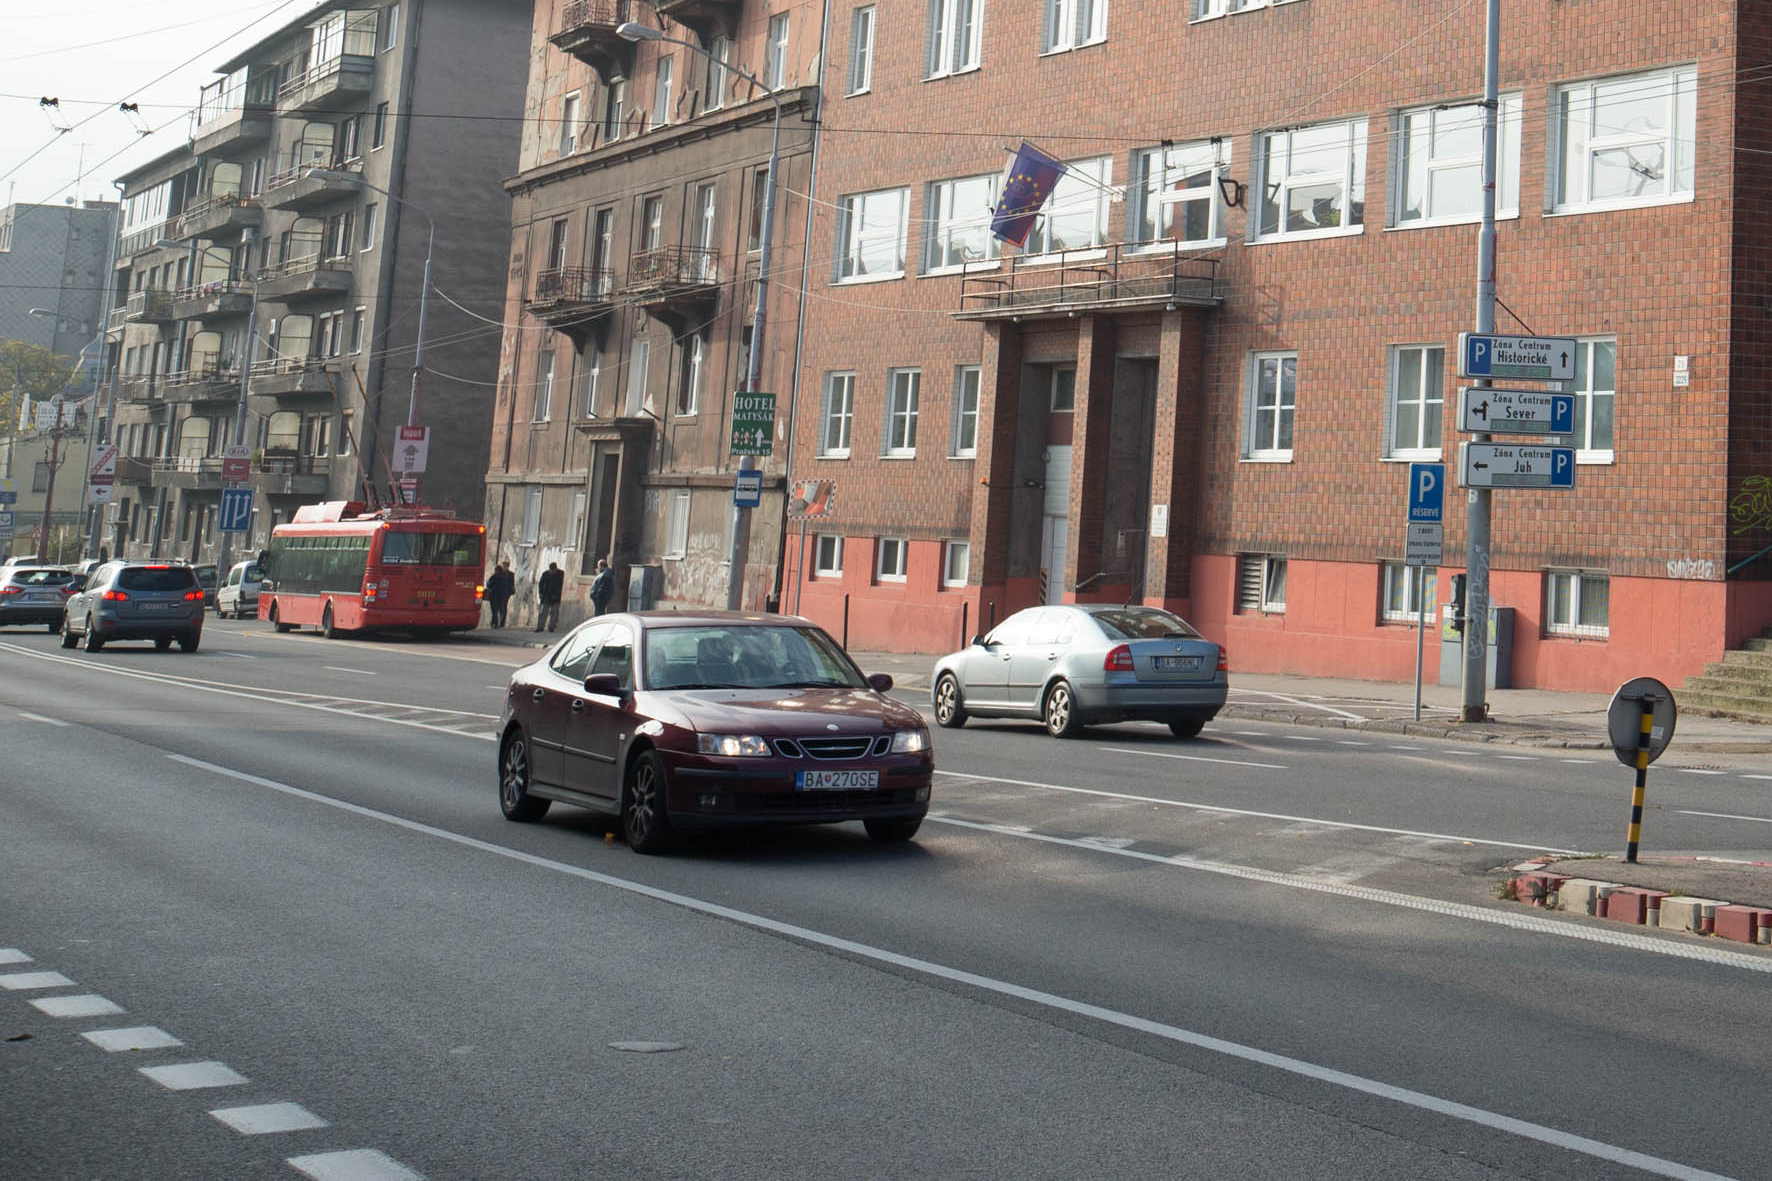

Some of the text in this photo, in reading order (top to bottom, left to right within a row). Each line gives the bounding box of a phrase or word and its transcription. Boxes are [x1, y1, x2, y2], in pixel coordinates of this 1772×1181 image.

[1493, 339, 1551, 350] Zóna Centrum
[1475, 342, 1486, 363] P
[1497, 351, 1548, 364] Historické
[735, 397, 775, 410] HOTEL
[1493, 393, 1551, 405] Zóna Centrum
[1505, 406, 1536, 419] Sever
[1556, 400, 1567, 421] P
[1494, 448, 1551, 459] Zóna Centrum
[1514, 461, 1532, 473] Juh
[1556, 454, 1567, 474] P
[1419, 470, 1436, 503] P
[805, 772, 824, 787] BA
